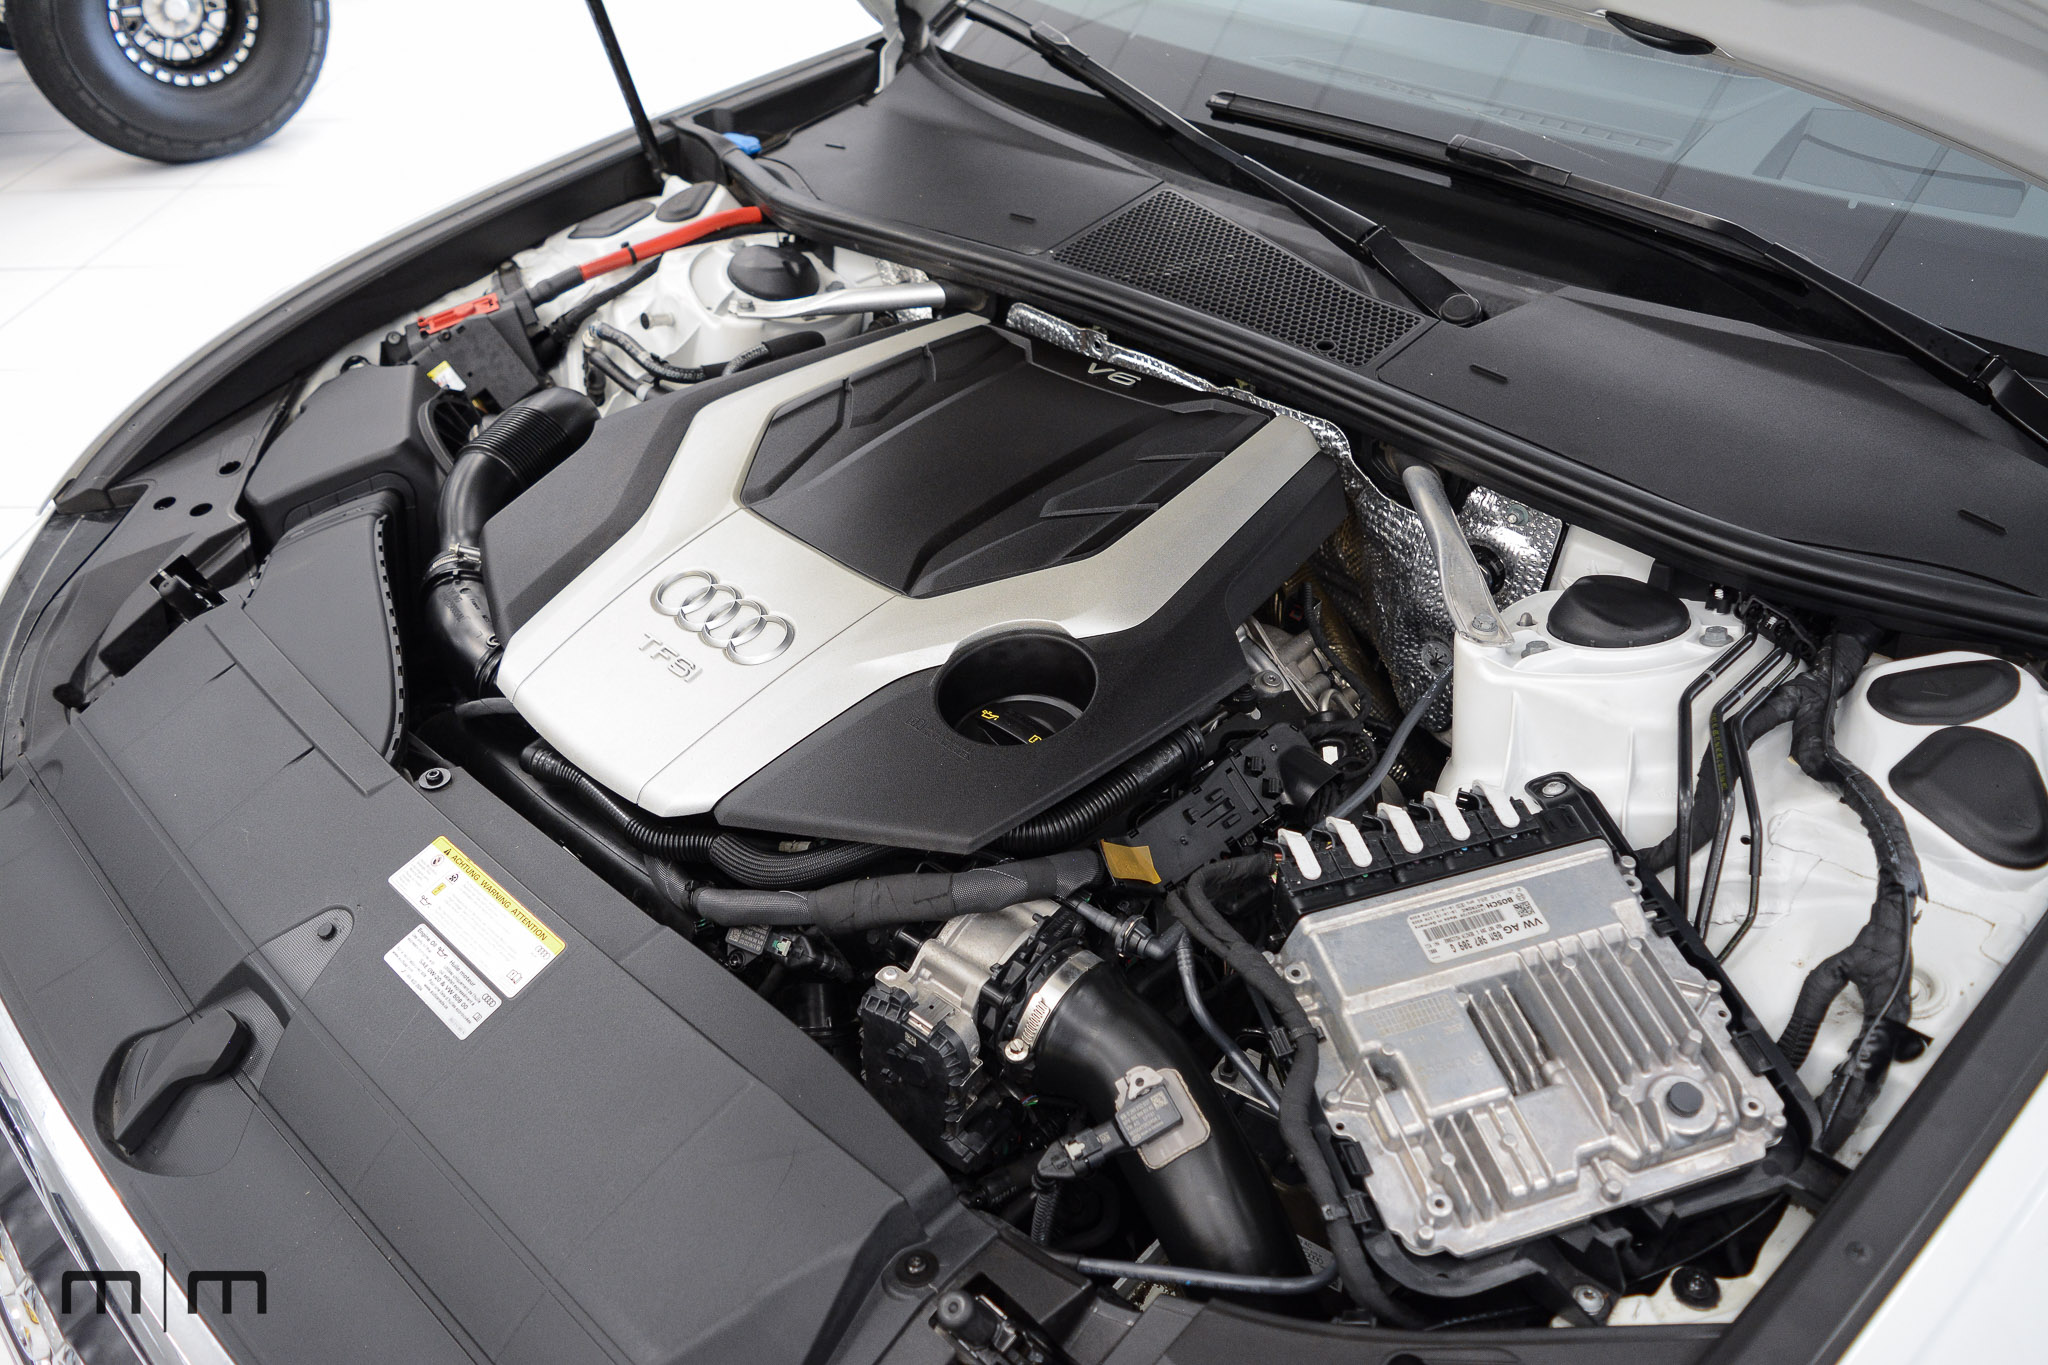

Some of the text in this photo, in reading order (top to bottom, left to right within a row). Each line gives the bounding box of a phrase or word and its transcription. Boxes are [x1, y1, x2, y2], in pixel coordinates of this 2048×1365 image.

[1088, 362, 1142, 386] V6
[639, 632, 703, 683] TFSI
[450, 854, 481, 881] ACHTUNG
[479, 879, 512, 908] WARNING
[510, 906, 548, 941] ATTENTION
[1485, 896, 1513, 908] BOSCH
[1501, 922, 1521, 934] AG
[1521, 917, 1543, 928] VW
[416, 927, 432, 942] Engine
[429, 939, 438, 947] Oil
[1472, 934, 1488, 946] 907
[448, 959, 476, 987] Huile moteur
[443, 984, 454, 995] VW
[459, 1001, 469, 1010] 00
